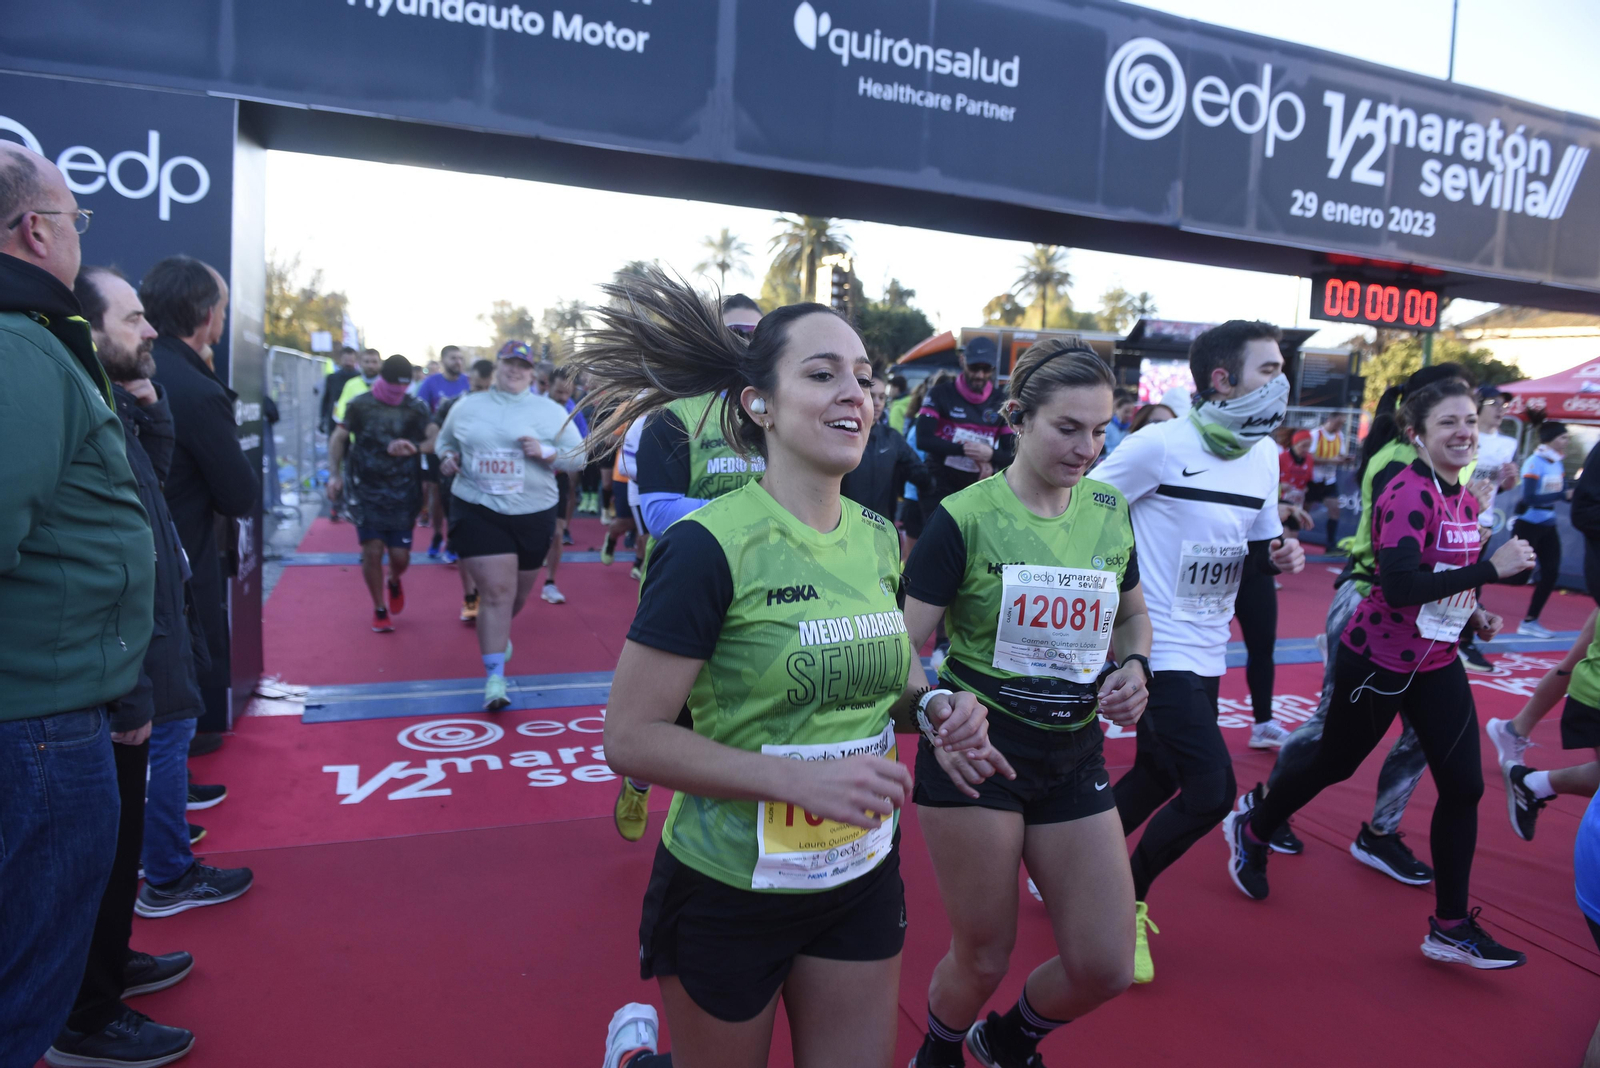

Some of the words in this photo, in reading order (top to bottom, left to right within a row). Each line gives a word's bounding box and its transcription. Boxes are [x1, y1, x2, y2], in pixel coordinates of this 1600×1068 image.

[552, 10, 650, 53] Motor
[858, 76, 951, 112] Healthcare
[955, 94, 1016, 123] Partner
[1192, 63, 1306, 158] edp
[1376, 102, 1550, 176] maratón
[57, 130, 210, 221] edp
[1419, 159, 1549, 219] sevilla
[1290, 188, 1318, 218] 29
[1322, 200, 1385, 229] enero
[1388, 206, 1436, 237] 2023
[707, 457, 748, 474] MEDIO
[1092, 491, 1117, 507] 2023
[1105, 554, 1125, 568] edp
[1188, 561, 1240, 585] 11911
[1033, 571, 1055, 585] edp
[767, 585, 820, 606] HOKA
[1013, 593, 1101, 632] 12081
[799, 617, 854, 647] MEDIO
[1051, 640, 1079, 648] Quintero
[1080, 640, 1097, 649] López
[1058, 650, 1077, 663] edp
[840, 841, 860, 857] edp
